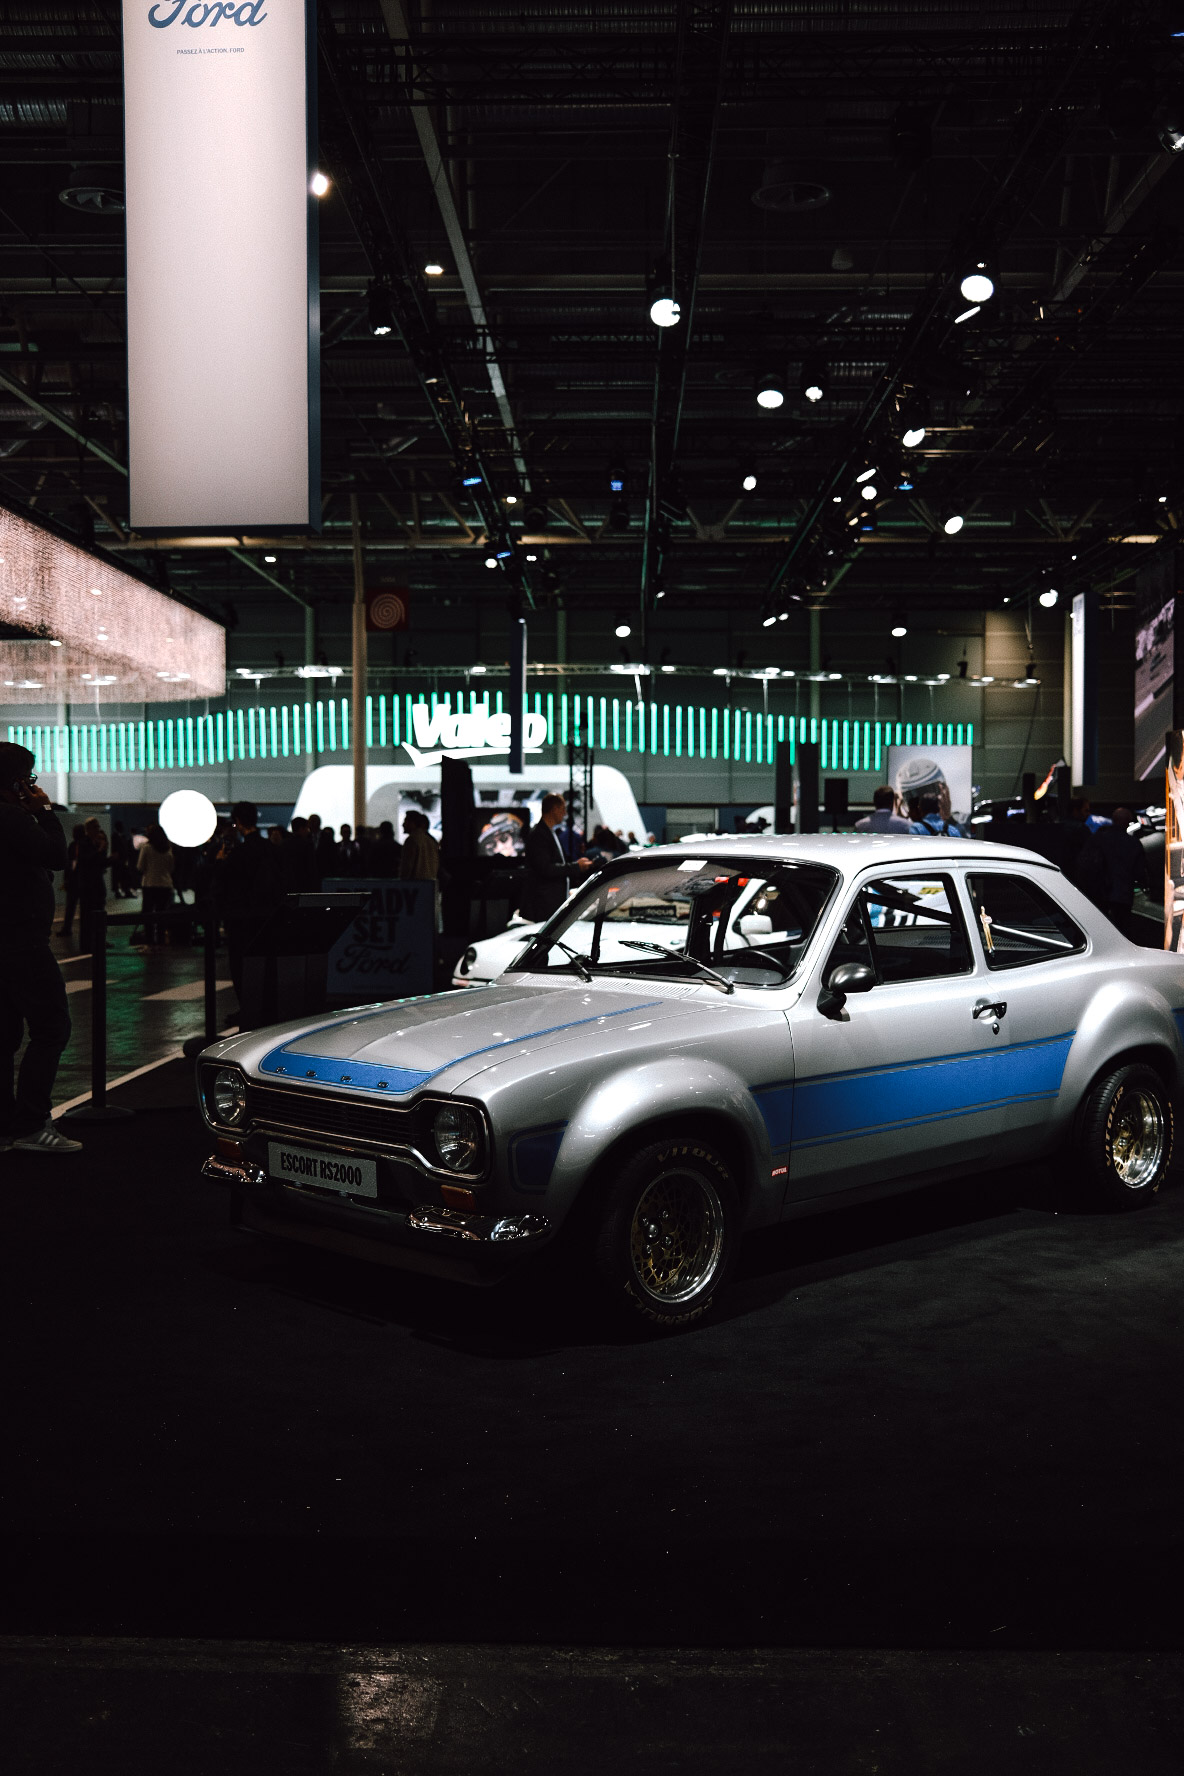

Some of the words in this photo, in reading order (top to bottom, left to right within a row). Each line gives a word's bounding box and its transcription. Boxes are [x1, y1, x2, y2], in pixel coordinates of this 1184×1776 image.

[148, 0, 268, 28] Ford
[412, 703, 548, 748] Valeo
[352, 916, 399, 943] SET
[336, 943, 413, 975] Ford
[280, 1152, 318, 1178] ESCORT
[320, 1160, 363, 1187] RS2000
